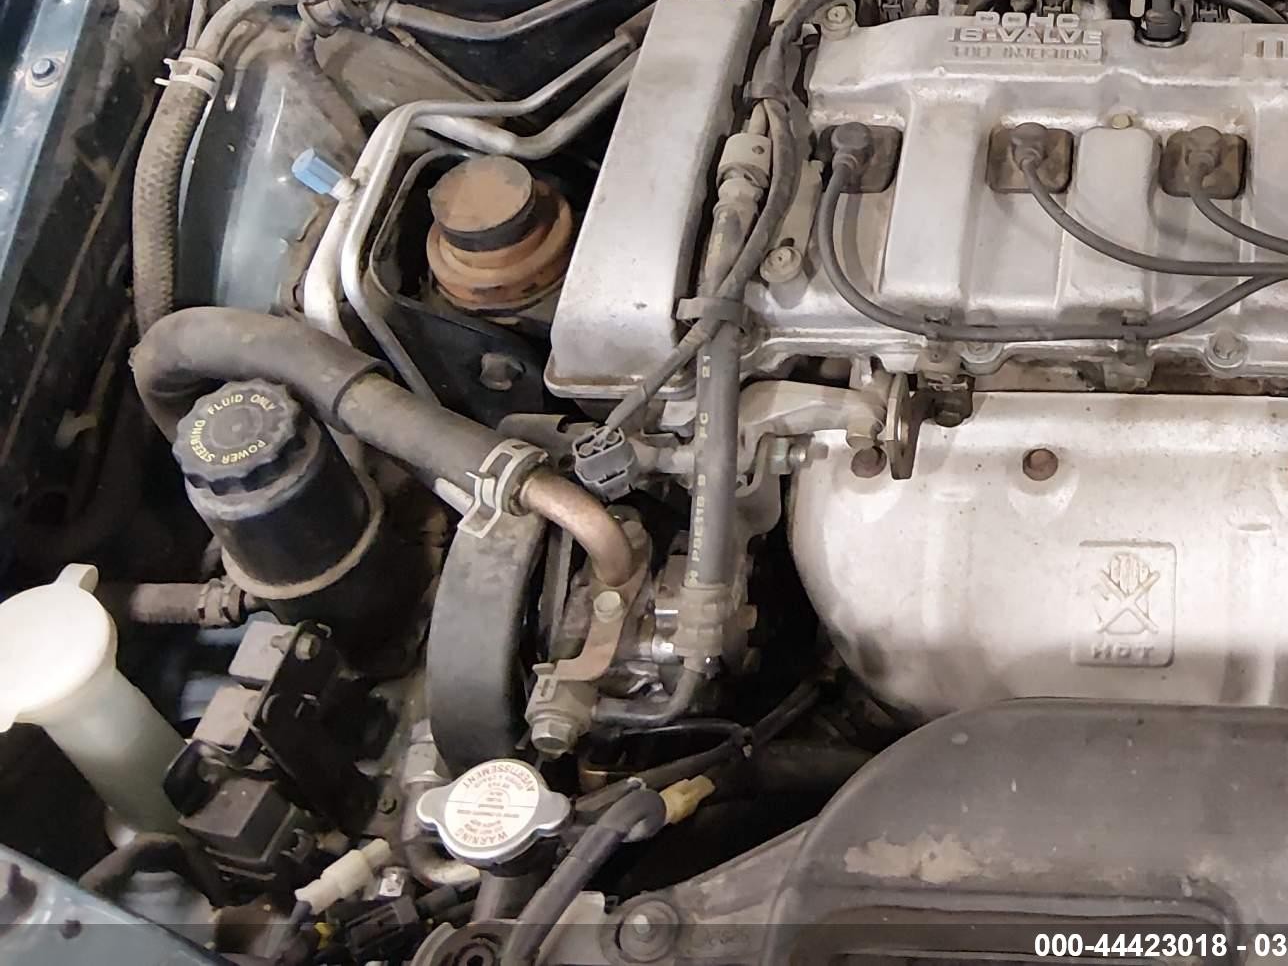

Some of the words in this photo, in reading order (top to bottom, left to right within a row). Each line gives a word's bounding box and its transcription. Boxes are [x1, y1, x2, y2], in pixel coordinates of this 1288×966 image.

[975, 11, 1080, 28] DOHC
[207, 394, 245, 416] FLUID
[250, 394, 278, 411] ONLY
[189, 419, 216, 464] STEERING
[220, 438, 267, 465] POWER
[1092, 645, 1155, 660] HOT
[454, 828, 508, 846] WARNING
